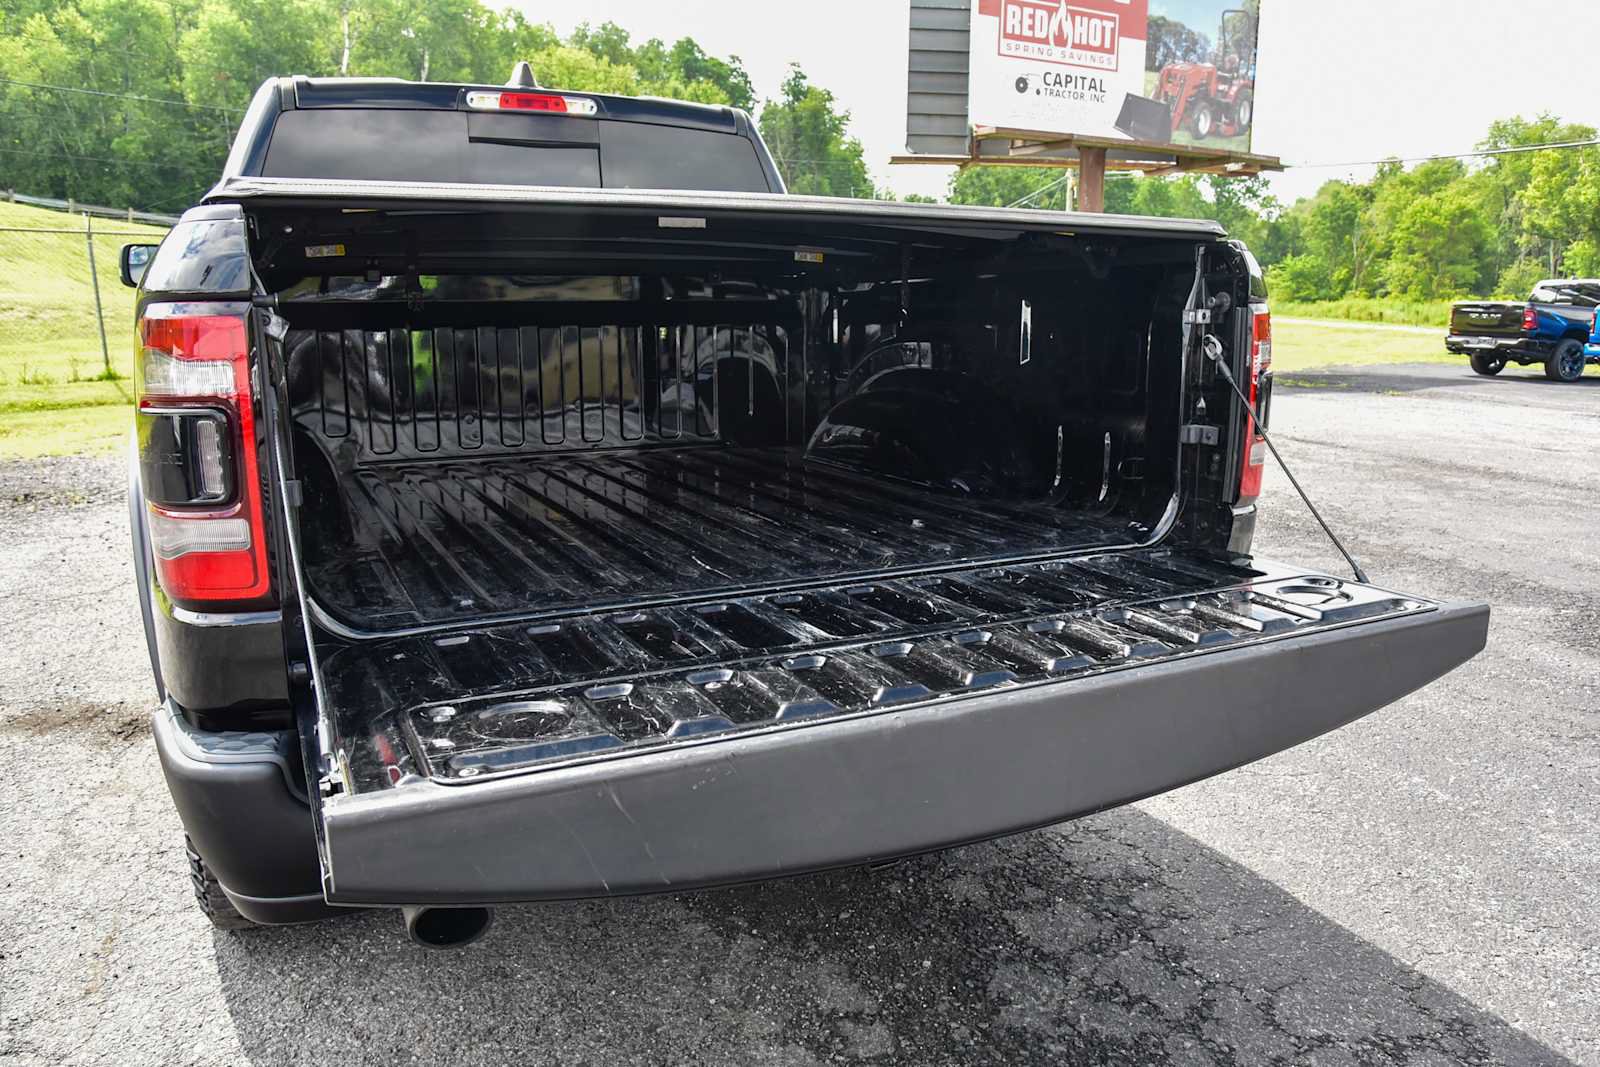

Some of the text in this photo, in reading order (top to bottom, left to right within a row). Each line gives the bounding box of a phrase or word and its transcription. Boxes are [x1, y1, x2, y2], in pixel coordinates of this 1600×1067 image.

[1006, 4, 1115, 49] RED HOT
[1006, 43, 1114, 65] SPRING SAVINGS
[1043, 72, 1107, 93] CAPITAL
[1043, 87, 1085, 100] TRACTOR
